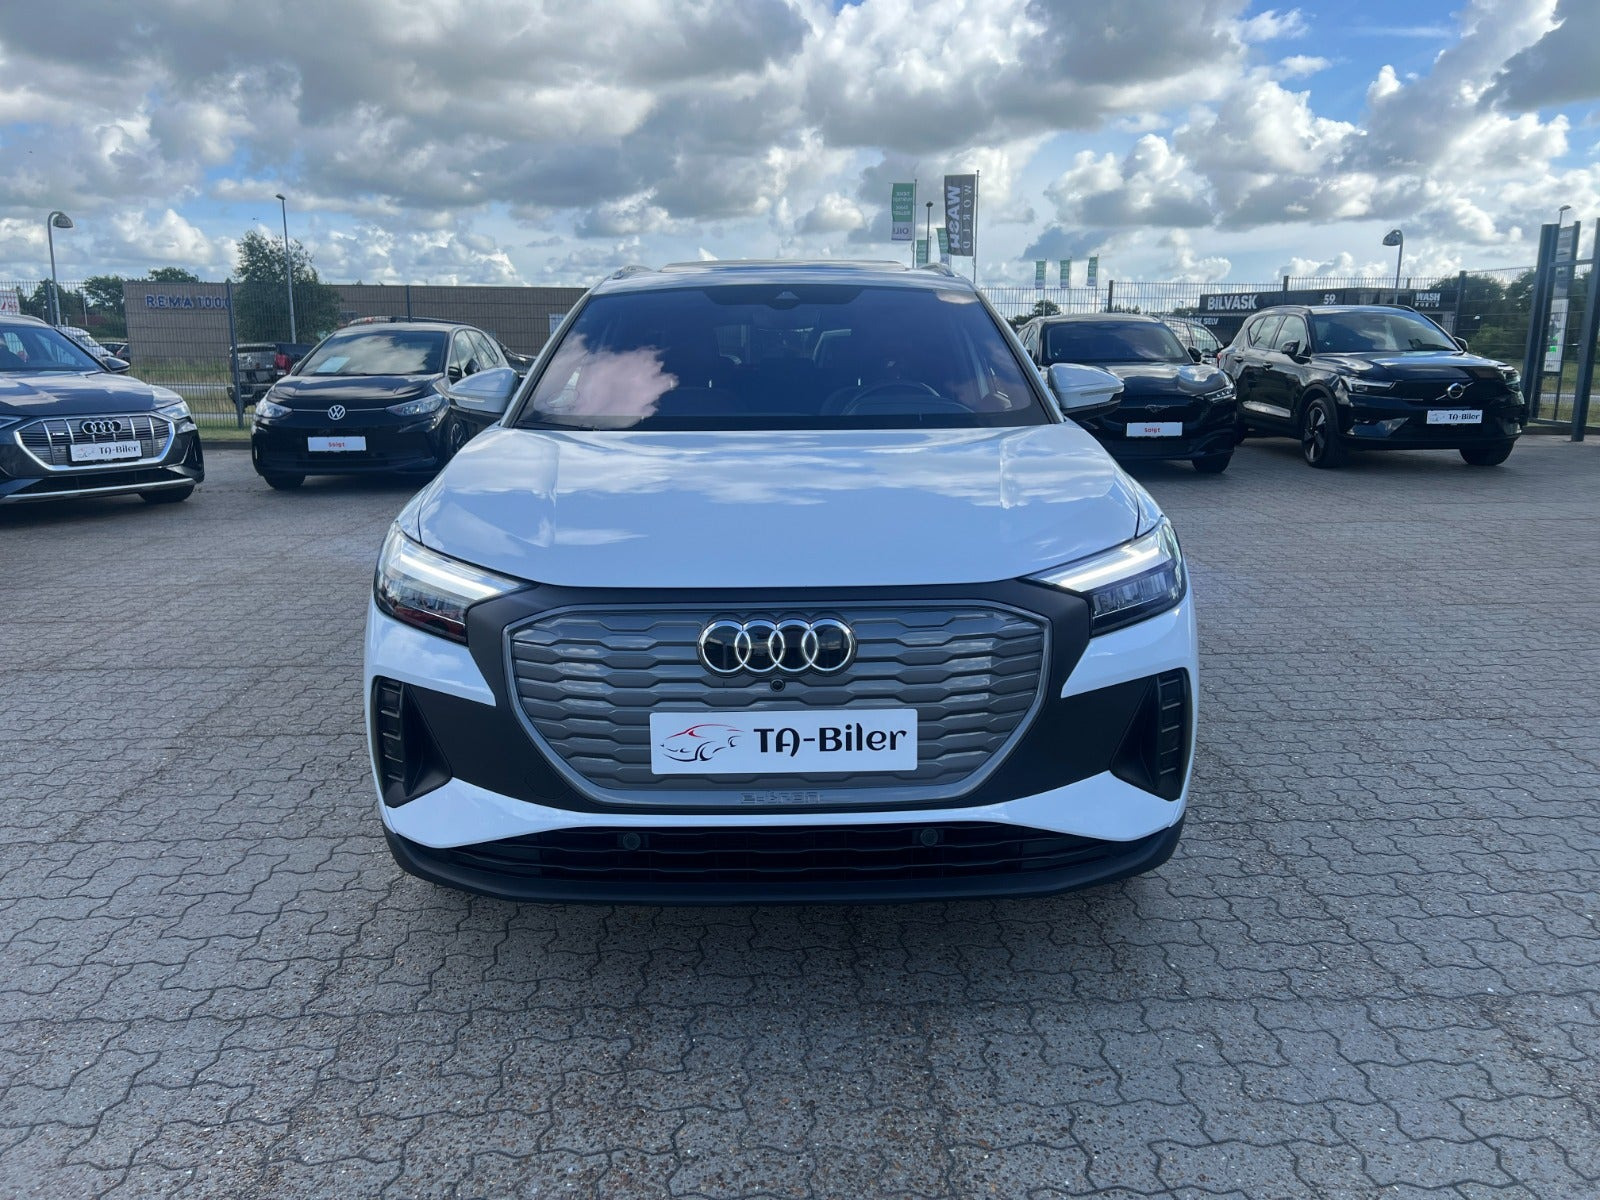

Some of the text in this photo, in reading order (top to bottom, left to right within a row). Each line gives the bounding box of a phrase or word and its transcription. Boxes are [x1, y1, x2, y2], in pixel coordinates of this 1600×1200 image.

[145, 295, 193, 309] REMA
[1207, 295, 1258, 311] BILVASK
[1416, 292, 1441, 301] WASH
[1448, 413, 1480, 421] TA-Biler
[99, 444, 139, 456] TA-Biler
[753, 722, 907, 757] TA-Biler
